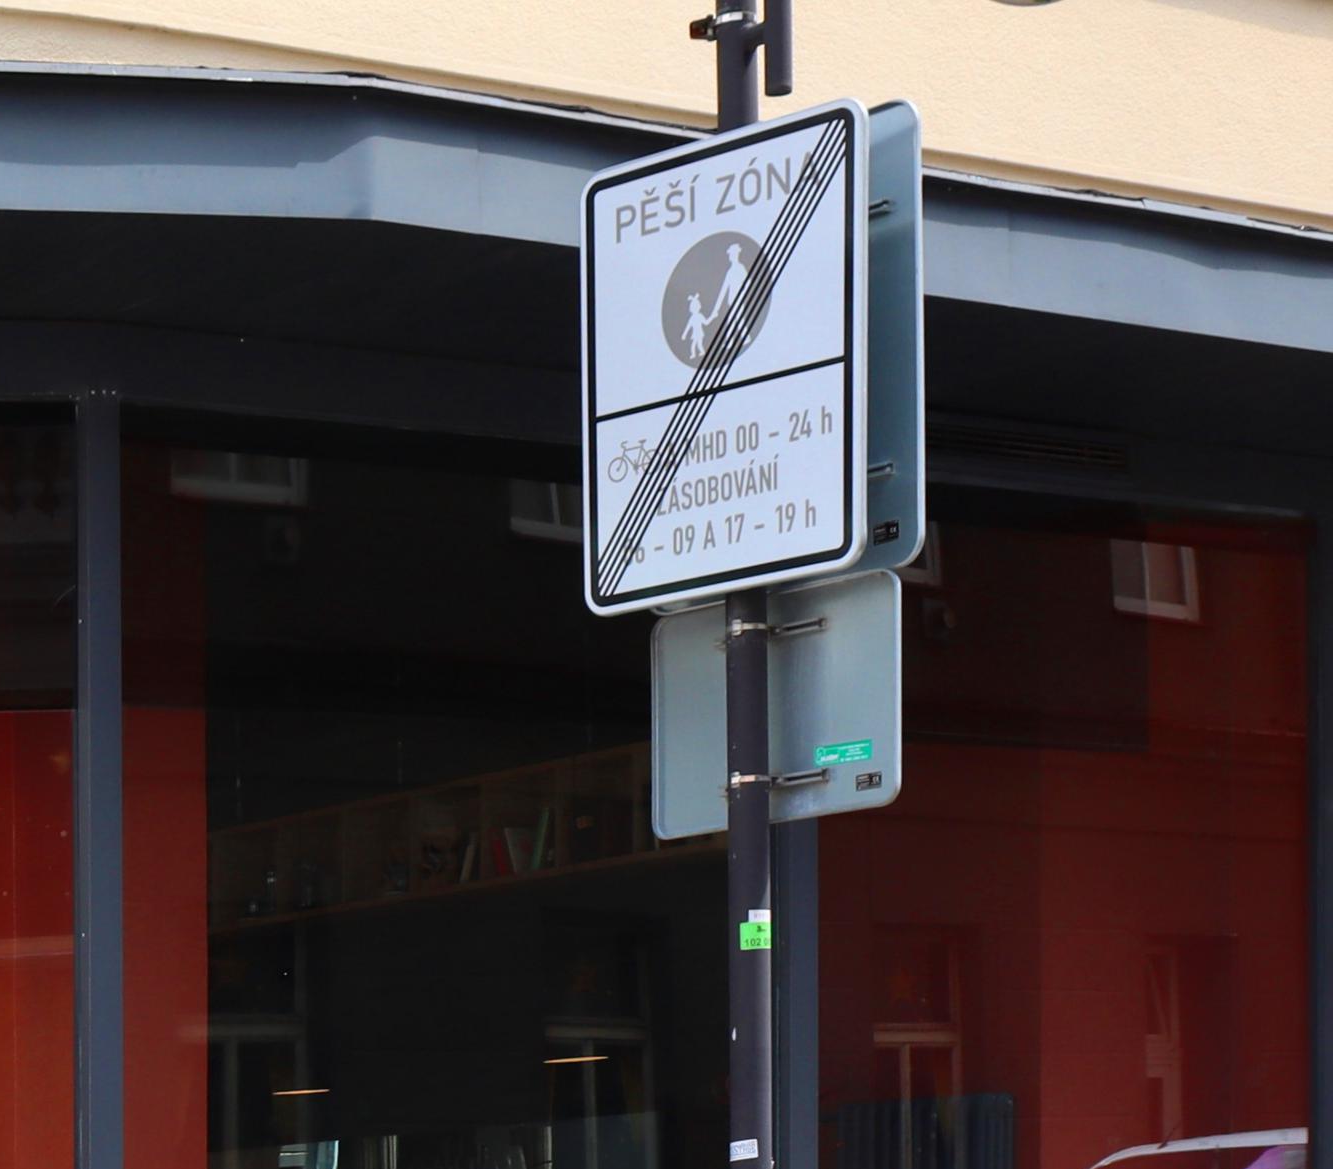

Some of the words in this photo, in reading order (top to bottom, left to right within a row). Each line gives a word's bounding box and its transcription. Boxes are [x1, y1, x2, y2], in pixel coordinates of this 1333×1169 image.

[615, 174, 700, 244] PĚŠÍ
[715, 151, 824, 215] ZÓNA
[684, 429, 728, 468] MHD
[735, 421, 760, 454] 00
[788, 408, 812, 443] 24
[820, 405, 833, 435] h
[673, 524, 696, 556] 09
[702, 519, 717, 550] A
[724, 512, 745, 545] 17
[775, 502, 797, 535] 19
[804, 499, 817, 529] h
